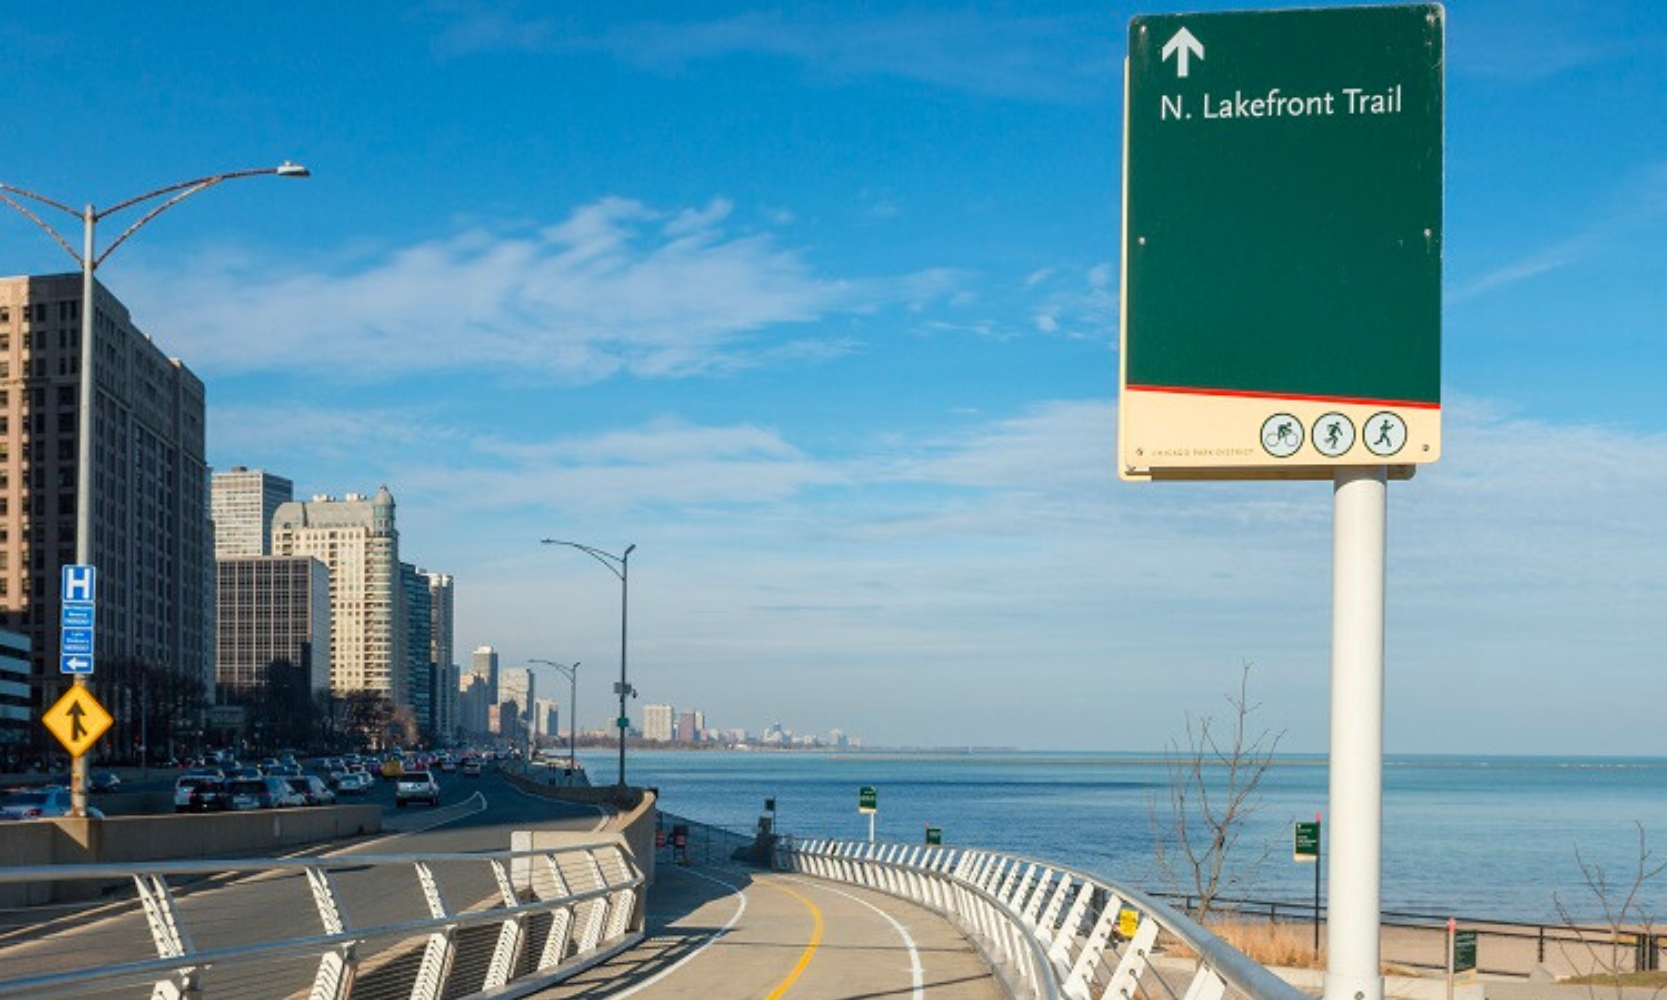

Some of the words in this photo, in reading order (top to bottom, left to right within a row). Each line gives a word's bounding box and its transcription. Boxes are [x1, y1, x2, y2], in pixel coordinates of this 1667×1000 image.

[1161, 94, 1192, 121] N.
[1203, 88, 1335, 119] Lakefront
[1342, 84, 1402, 114] Trail
[66, 568, 91, 599] H
